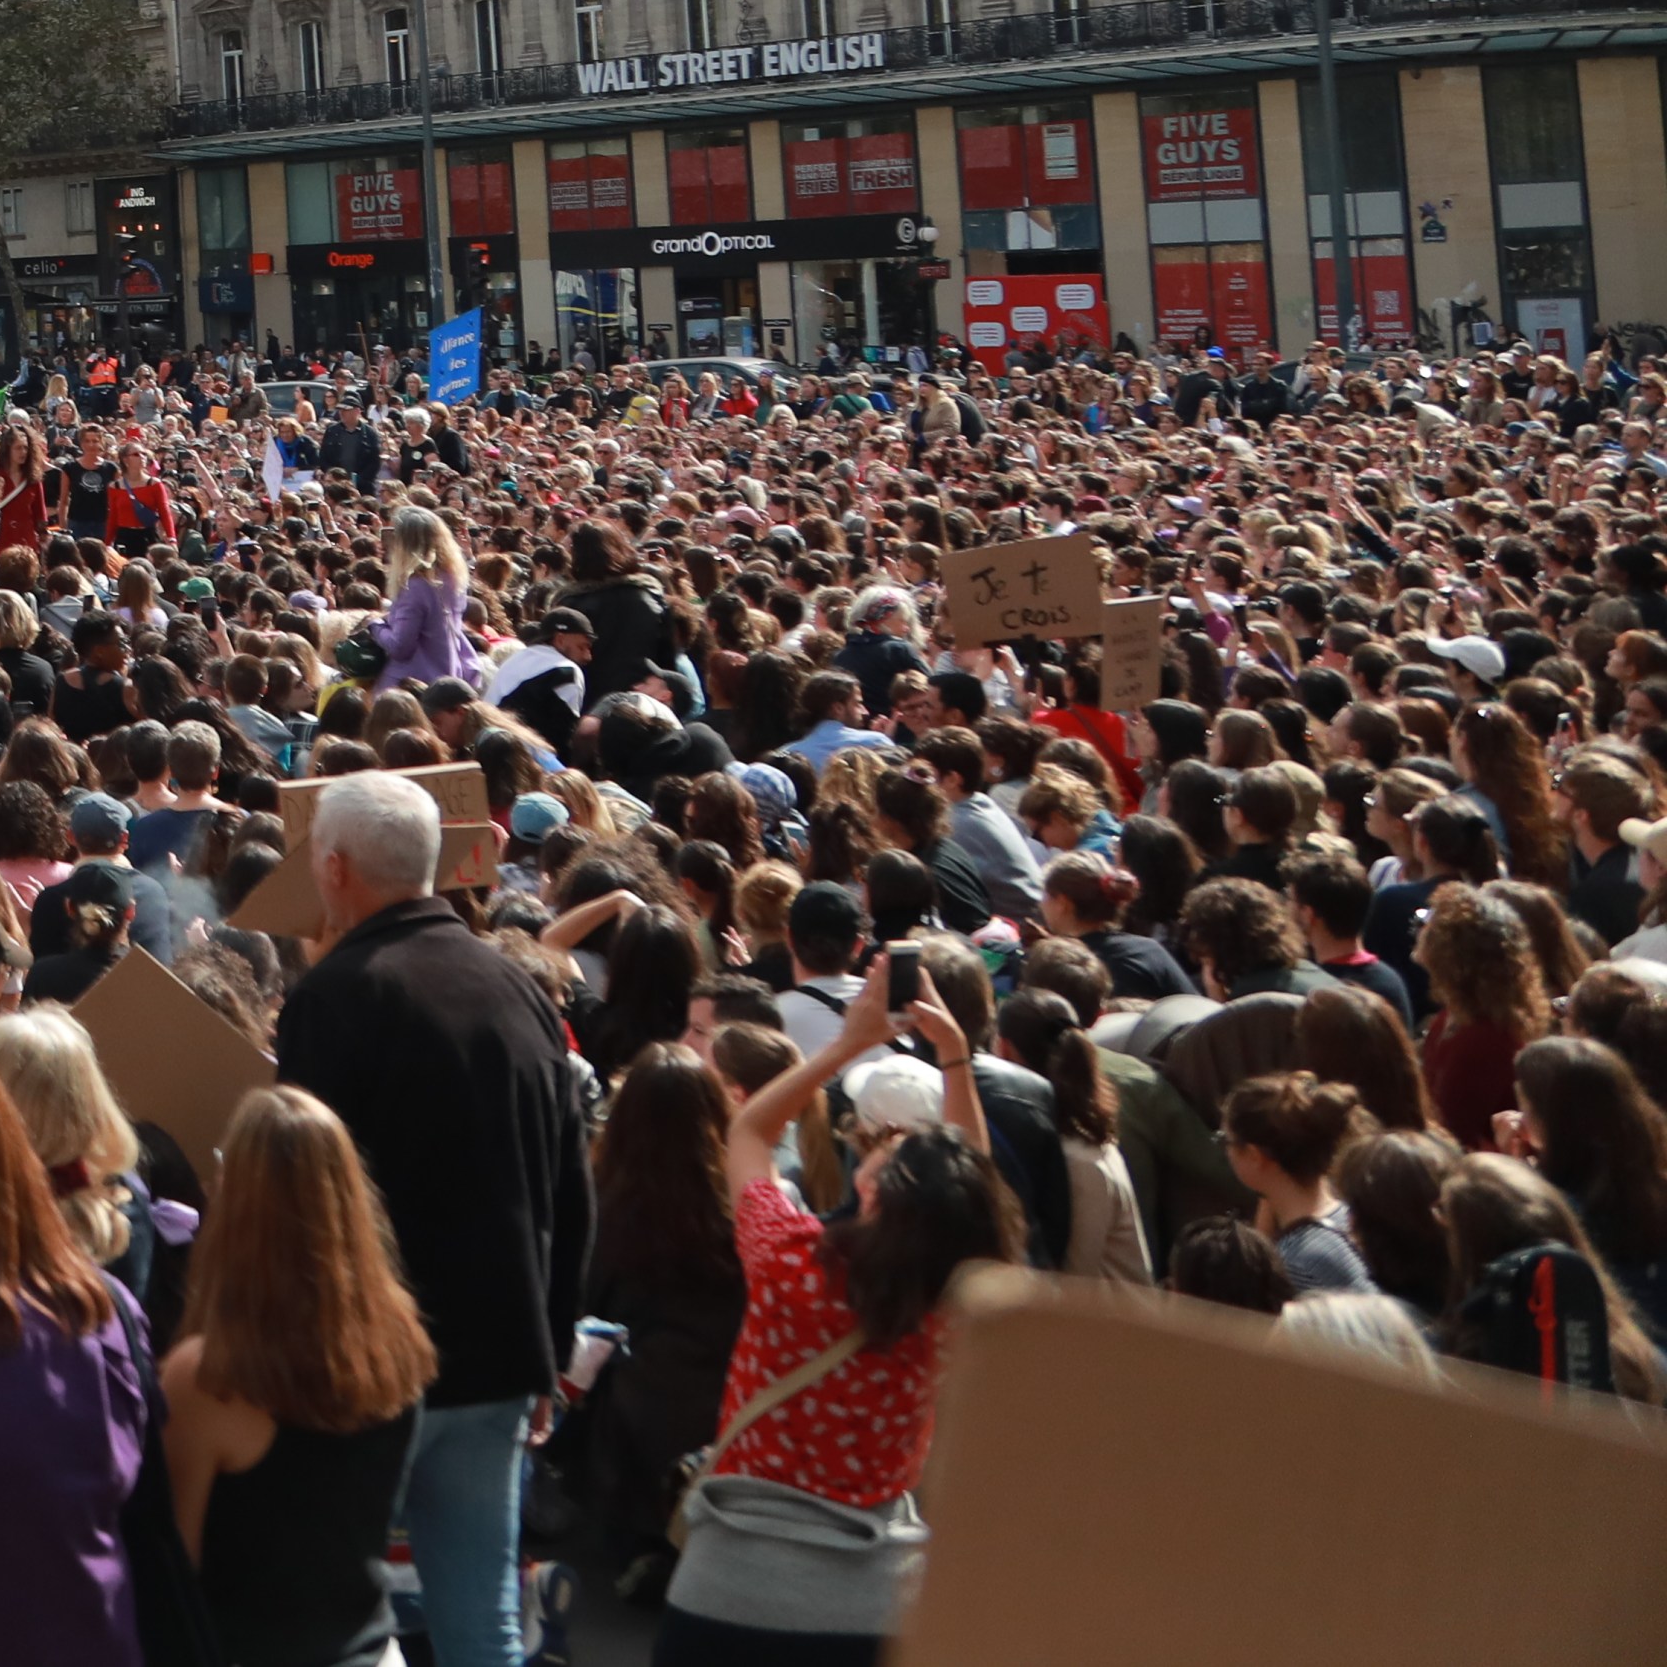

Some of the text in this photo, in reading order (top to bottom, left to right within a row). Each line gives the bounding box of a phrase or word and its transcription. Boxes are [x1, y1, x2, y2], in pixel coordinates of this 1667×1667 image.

[577, 33, 885, 94] WALL STREET ENGLISH
[1163, 113, 1230, 138] FIVE
[1157, 138, 1241, 165] GUYS
[353, 173, 395, 193] FIVE
[797, 181, 838, 193] FRIES
[853, 167, 913, 189] FRESH
[350, 193, 402, 213] GUYS
[24, 261, 58, 276] celio
[328, 252, 375, 269] Orange
[970, 559, 1053, 606] Je te
